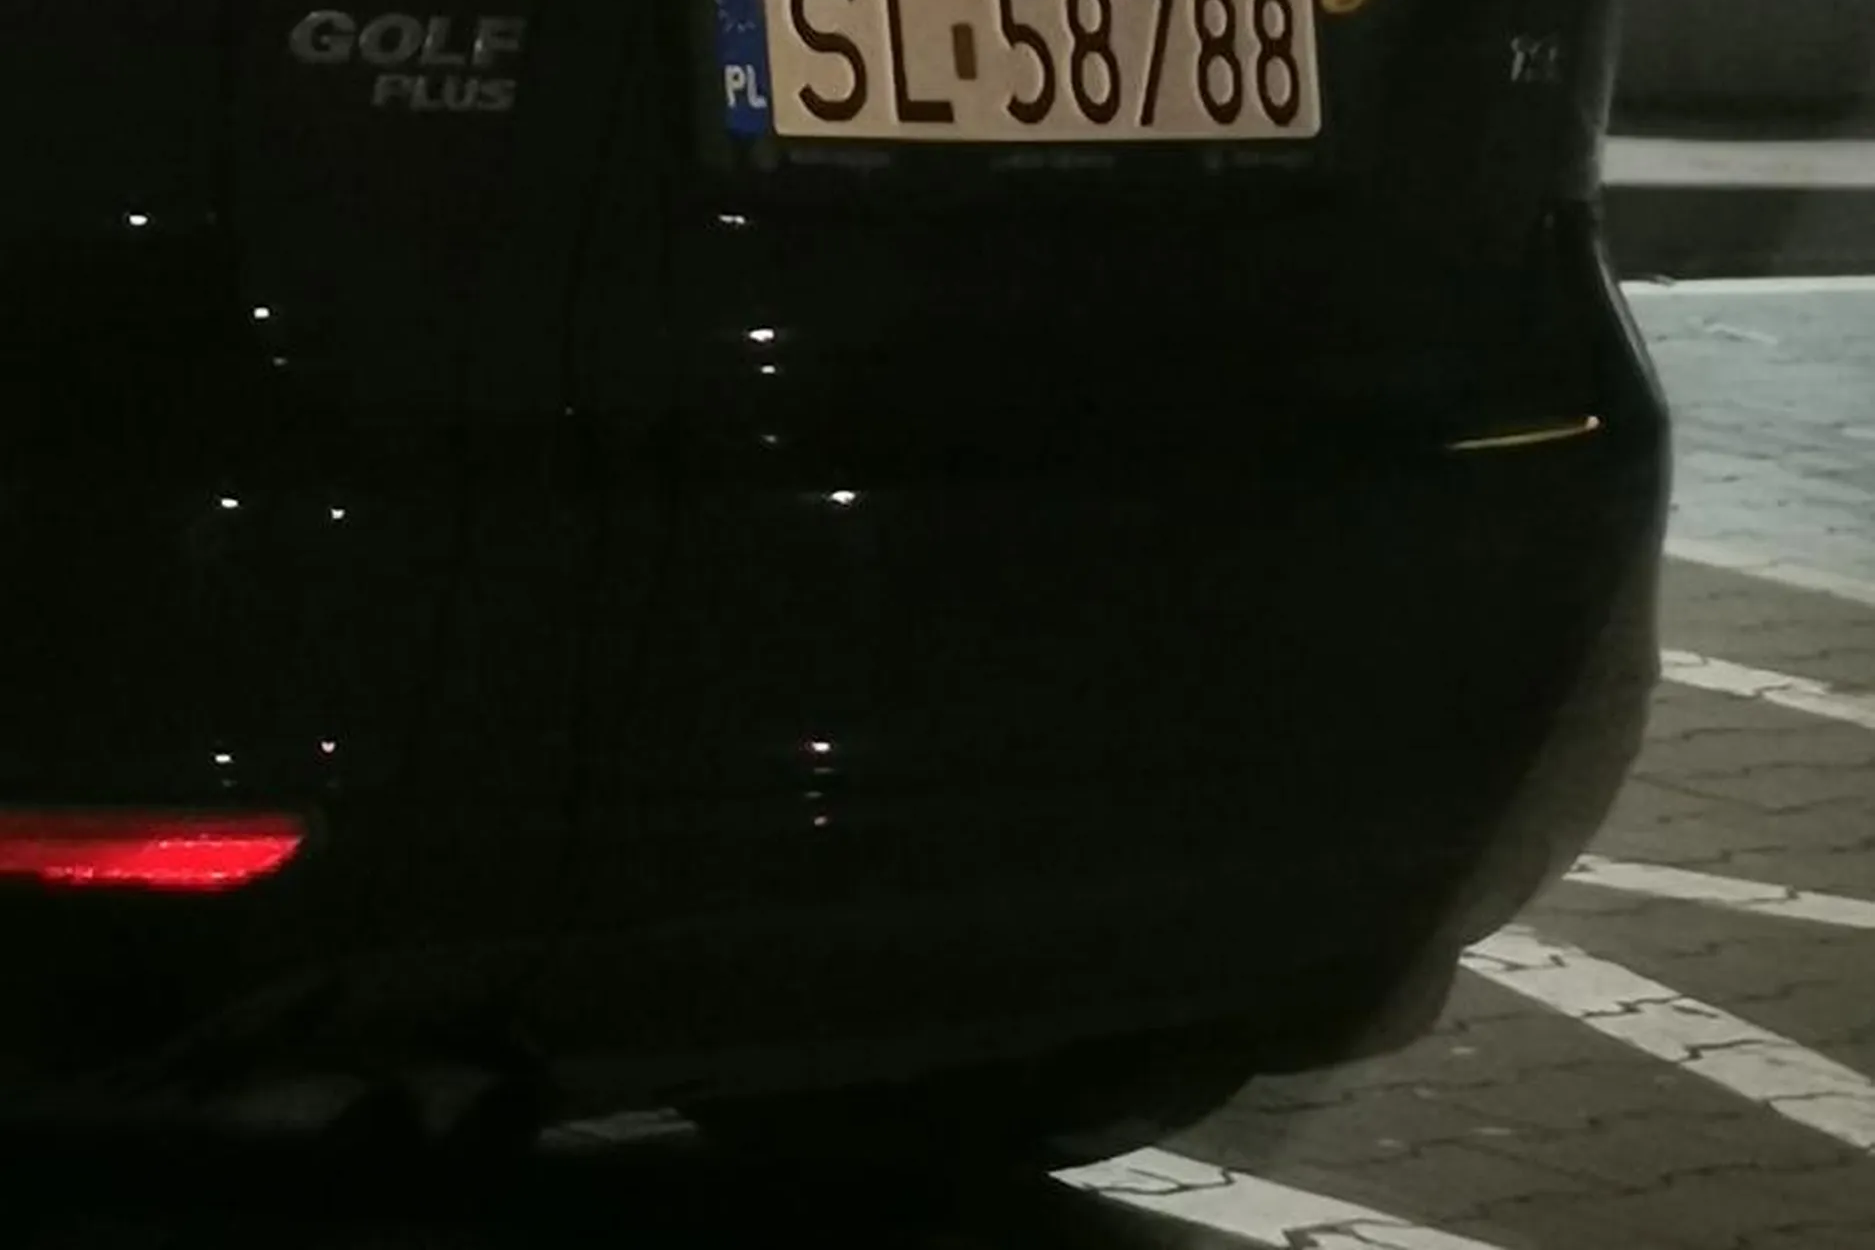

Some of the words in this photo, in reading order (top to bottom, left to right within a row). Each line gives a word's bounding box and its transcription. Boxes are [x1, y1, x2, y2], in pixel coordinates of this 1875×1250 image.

[290, 10, 527, 66] GOLF
[371, 75, 516, 111] PLUS
[724, 63, 767, 108] PL
